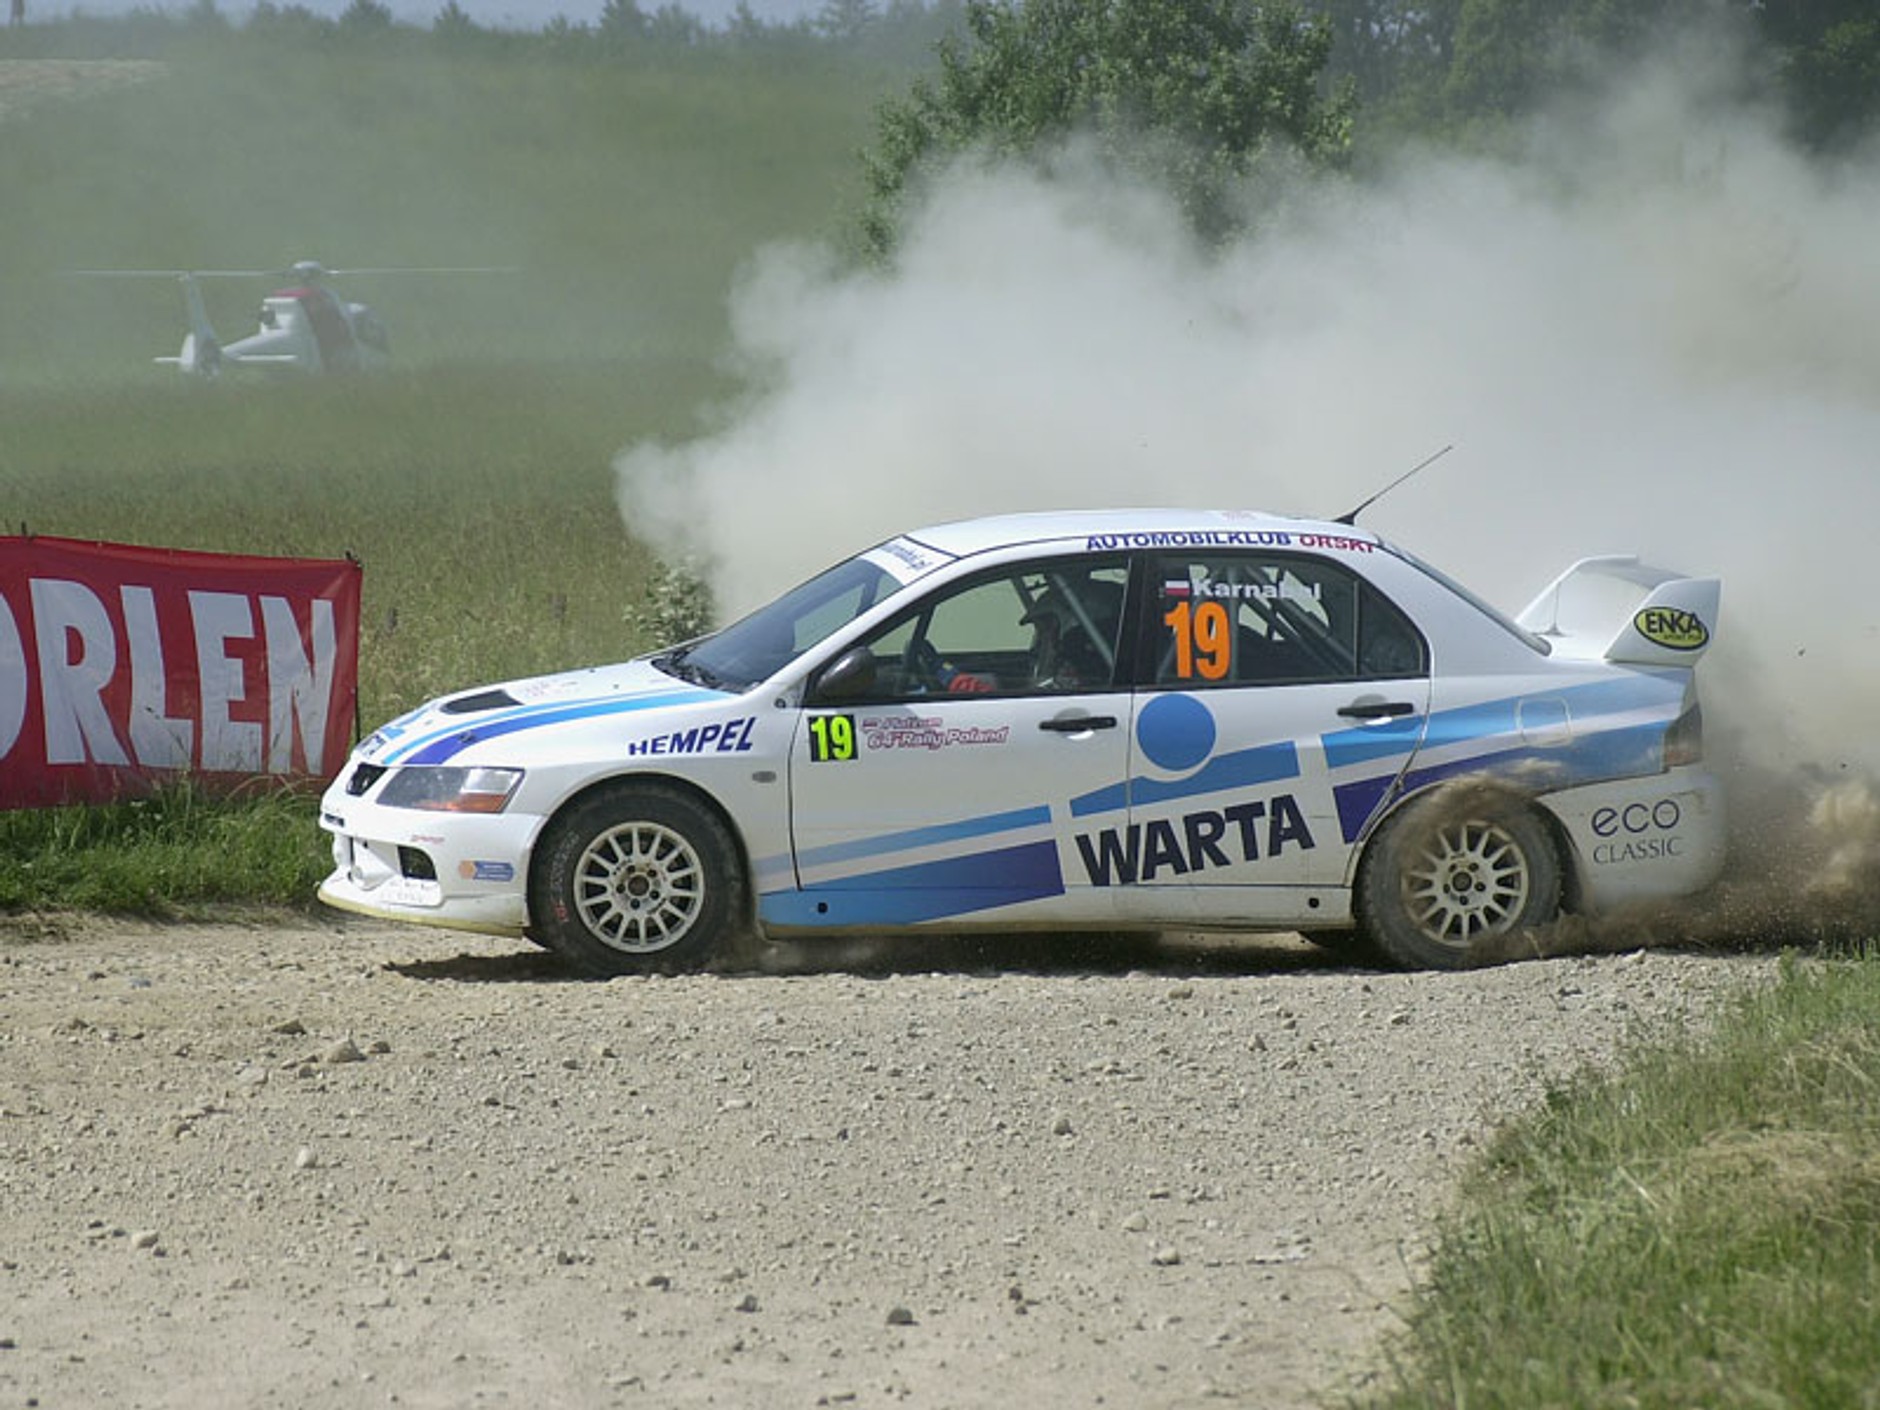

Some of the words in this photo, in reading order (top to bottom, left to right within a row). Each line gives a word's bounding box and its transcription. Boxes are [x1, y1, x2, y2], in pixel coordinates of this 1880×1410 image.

[1086, 531, 1292, 550] AUTOMOBILKLUB
[1164, 600, 1231, 680] 19
[1645, 611, 1703, 638] ENKA
[628, 716, 757, 756] HEMPEL
[810, 715, 854, 761] 19
[901, 729, 943, 749] Rally
[947, 726, 1010, 745] Poland
[1591, 799, 1680, 838] eco
[1074, 794, 1316, 887] WARTA
[1593, 836, 1685, 865] CLASSIC
